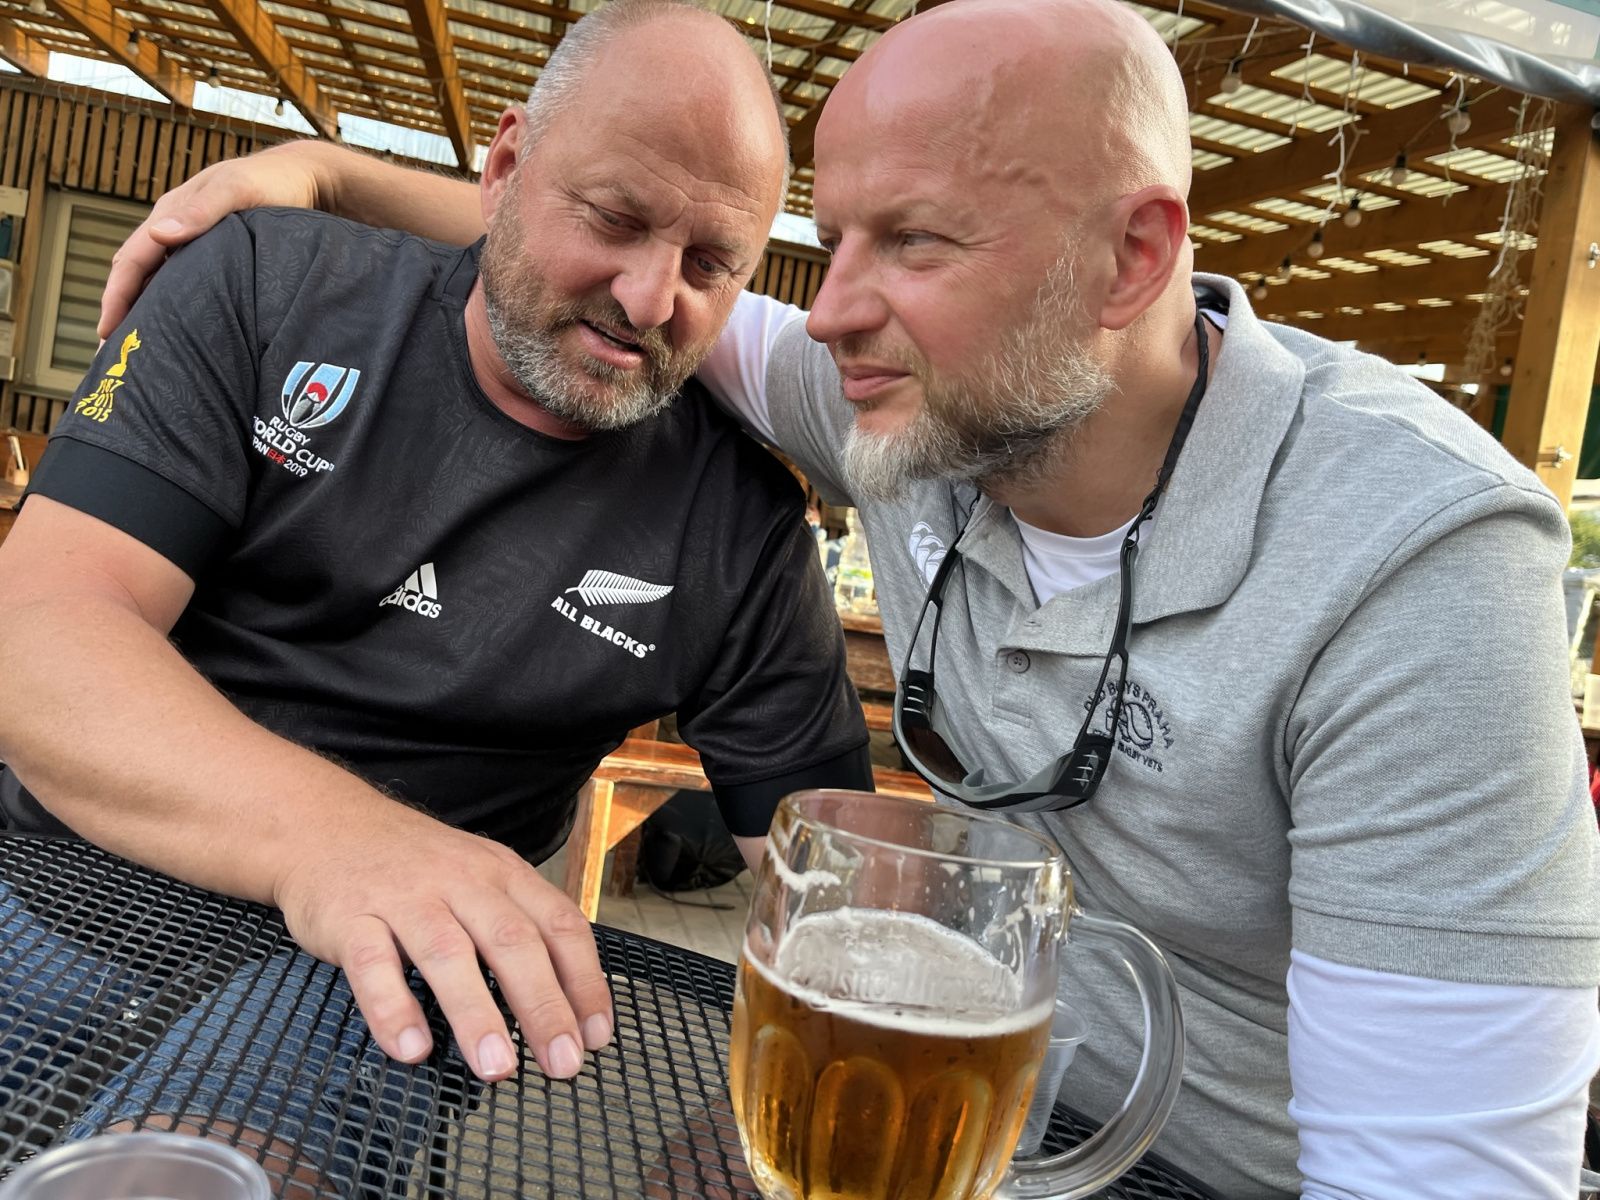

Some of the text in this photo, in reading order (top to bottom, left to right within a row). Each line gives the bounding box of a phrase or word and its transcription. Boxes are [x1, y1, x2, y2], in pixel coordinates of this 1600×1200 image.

[74, 400, 113, 423] 2015
[82, 392, 114, 410] 2011
[253, 415, 330, 473] ORLD CUP
[269, 415, 312, 447] RUGBY
[252, 435, 270, 456] PAN
[283, 459, 309, 478] 2019
[378, 584, 443, 619] adidas
[550, 595, 649, 659] ALL BLACKS
[1107, 680, 1141, 698] BYS
[1142, 689, 1175, 749] PRAHA
